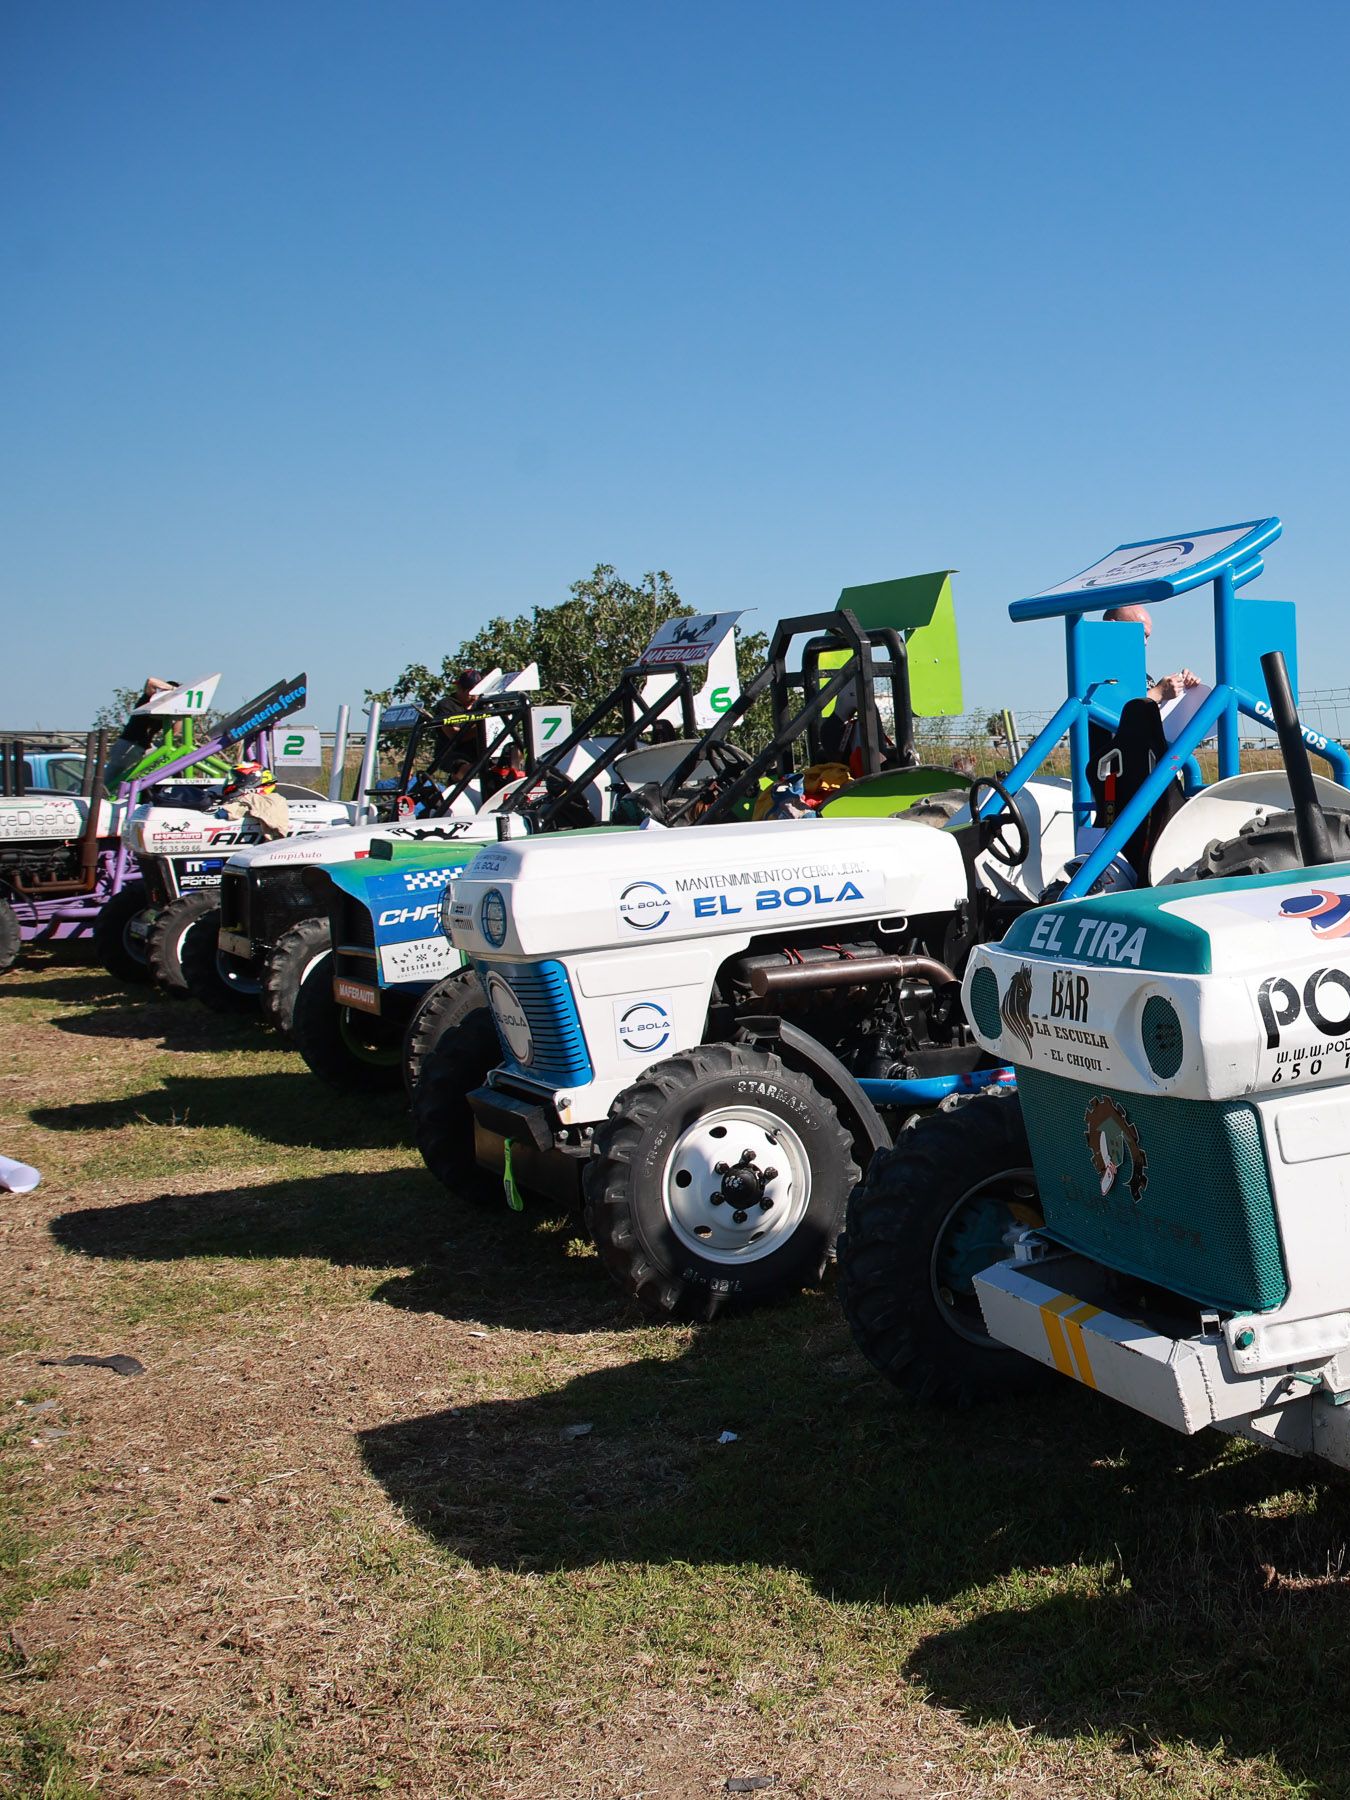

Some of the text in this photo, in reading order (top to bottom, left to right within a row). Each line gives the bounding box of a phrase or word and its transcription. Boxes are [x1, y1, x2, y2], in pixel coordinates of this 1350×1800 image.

[645, 647, 708, 660] MAFERAUTO
[186, 690, 203, 708] 11
[710, 687, 732, 713] 6
[542, 717, 562, 740] 7
[283, 735, 305, 755] 2
[637, 899, 671, 909] BOLA
[693, 881, 864, 918] EL BOLA
[1029, 914, 1147, 966] EL TIRA
[1050, 971, 1089, 1023] BAR
[620, 1021, 671, 1034] EL BOLA
[1034, 1022, 1109, 1049] LA ESCUELA
[1050, 1049, 1064, 1062] EL
[1067, 1052, 1103, 1073] CHIQUI
